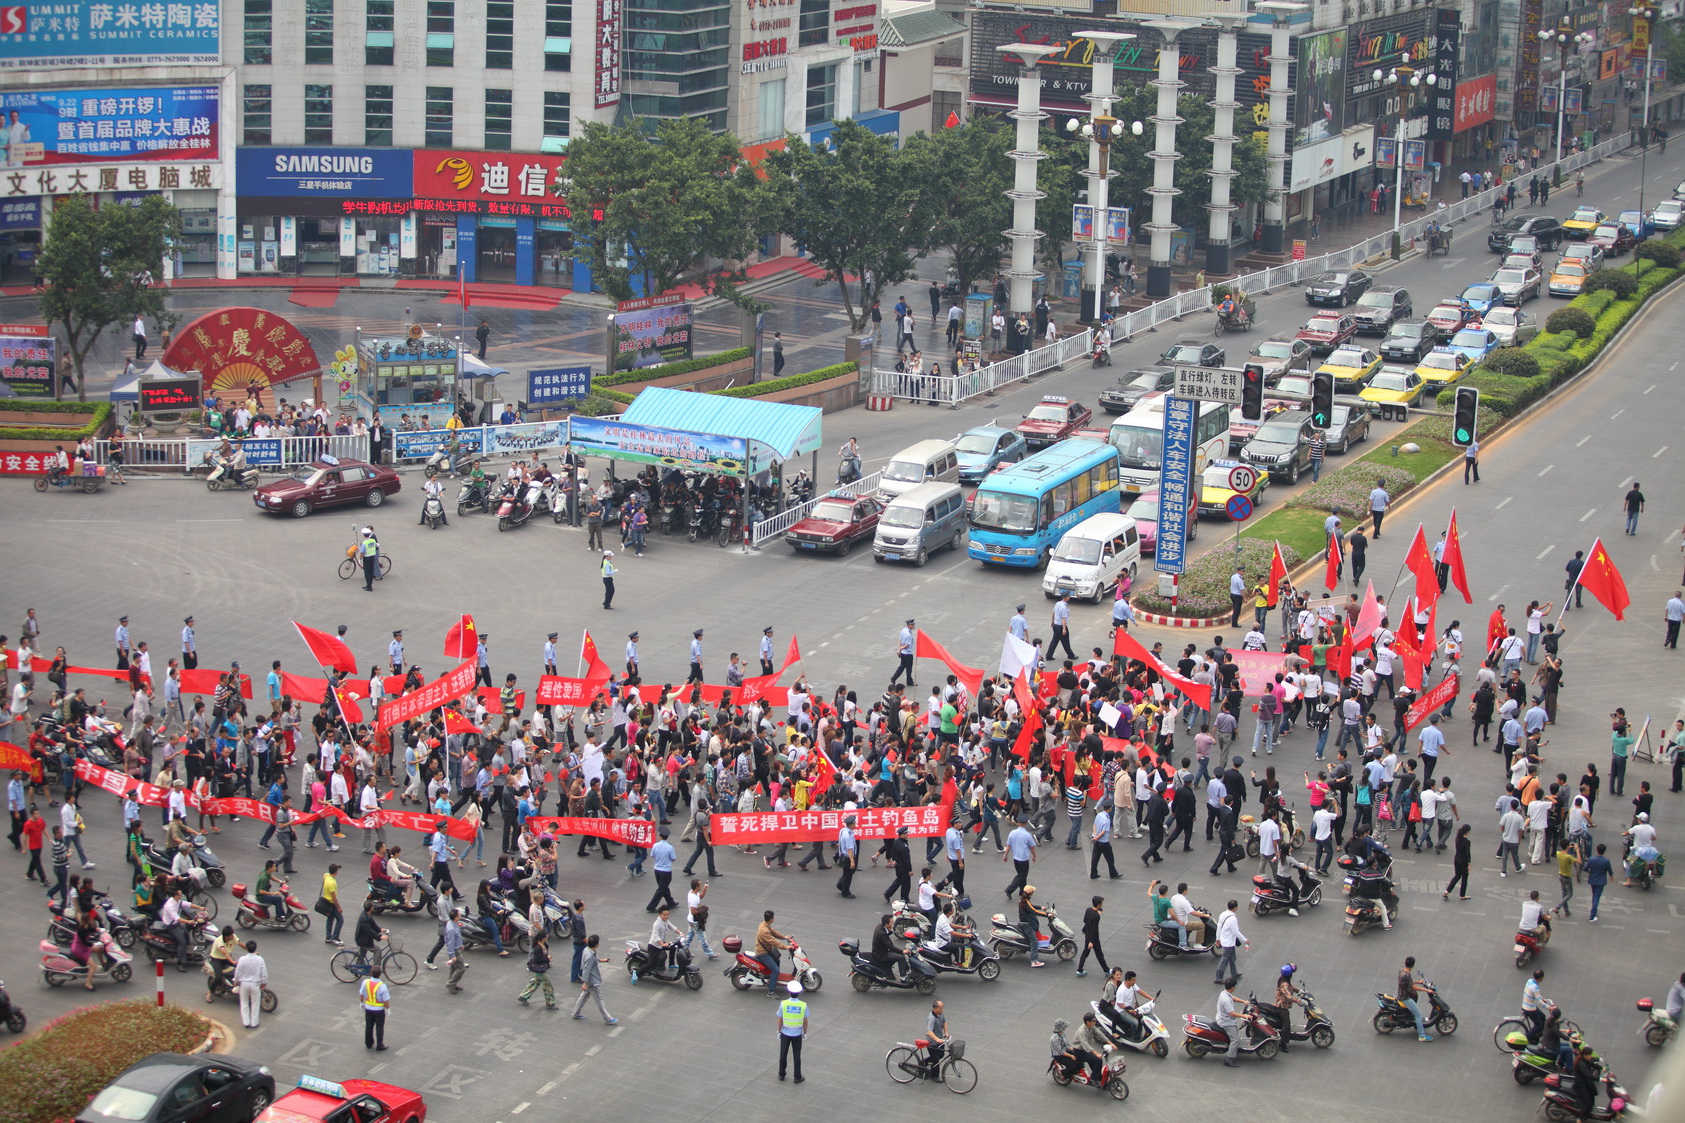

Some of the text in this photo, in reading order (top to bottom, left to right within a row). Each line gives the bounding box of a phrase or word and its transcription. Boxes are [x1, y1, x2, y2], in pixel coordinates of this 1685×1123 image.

[89, 3, 218, 29] 萨米特陶瓷
[89, 30, 218, 39] SUMMIT CERAMICS
[1066, 82, 1087, 91] KTV
[1436, 38, 1454, 130] 大光明眼镜
[59, 107, 77, 117] 9时
[57, 117, 211, 140] 暨首届品牌大惠战
[57, 138, 211, 153] 百姓省钱集中赢 价格解放全桂林
[275, 155, 373, 173] SAMSUNG
[7, 165, 212, 195] 文化大厦电脑城
[298, 180, 353, 190] 三星手机体验店
[619, 314, 688, 336] 文明桂林 我的责任
[619, 336, 652, 353] 桂林文明
[656, 330, 688, 347] 我的光荣
[3, 347, 49, 360] 我的责任
[3, 366, 49, 379] 我的光荣
[534, 373, 586, 385] 规范执法行为
[1180, 369, 1237, 386] 直行绿灯，左转
[534, 385, 586, 397] 创建和谐交通
[1179, 384, 1236, 401] 车辆进入待转区
[0, 455, 58, 470] 安全线
[1235, 472, 1250, 487] 50
[384, 682, 449, 725] 打倒日本帝国主义
